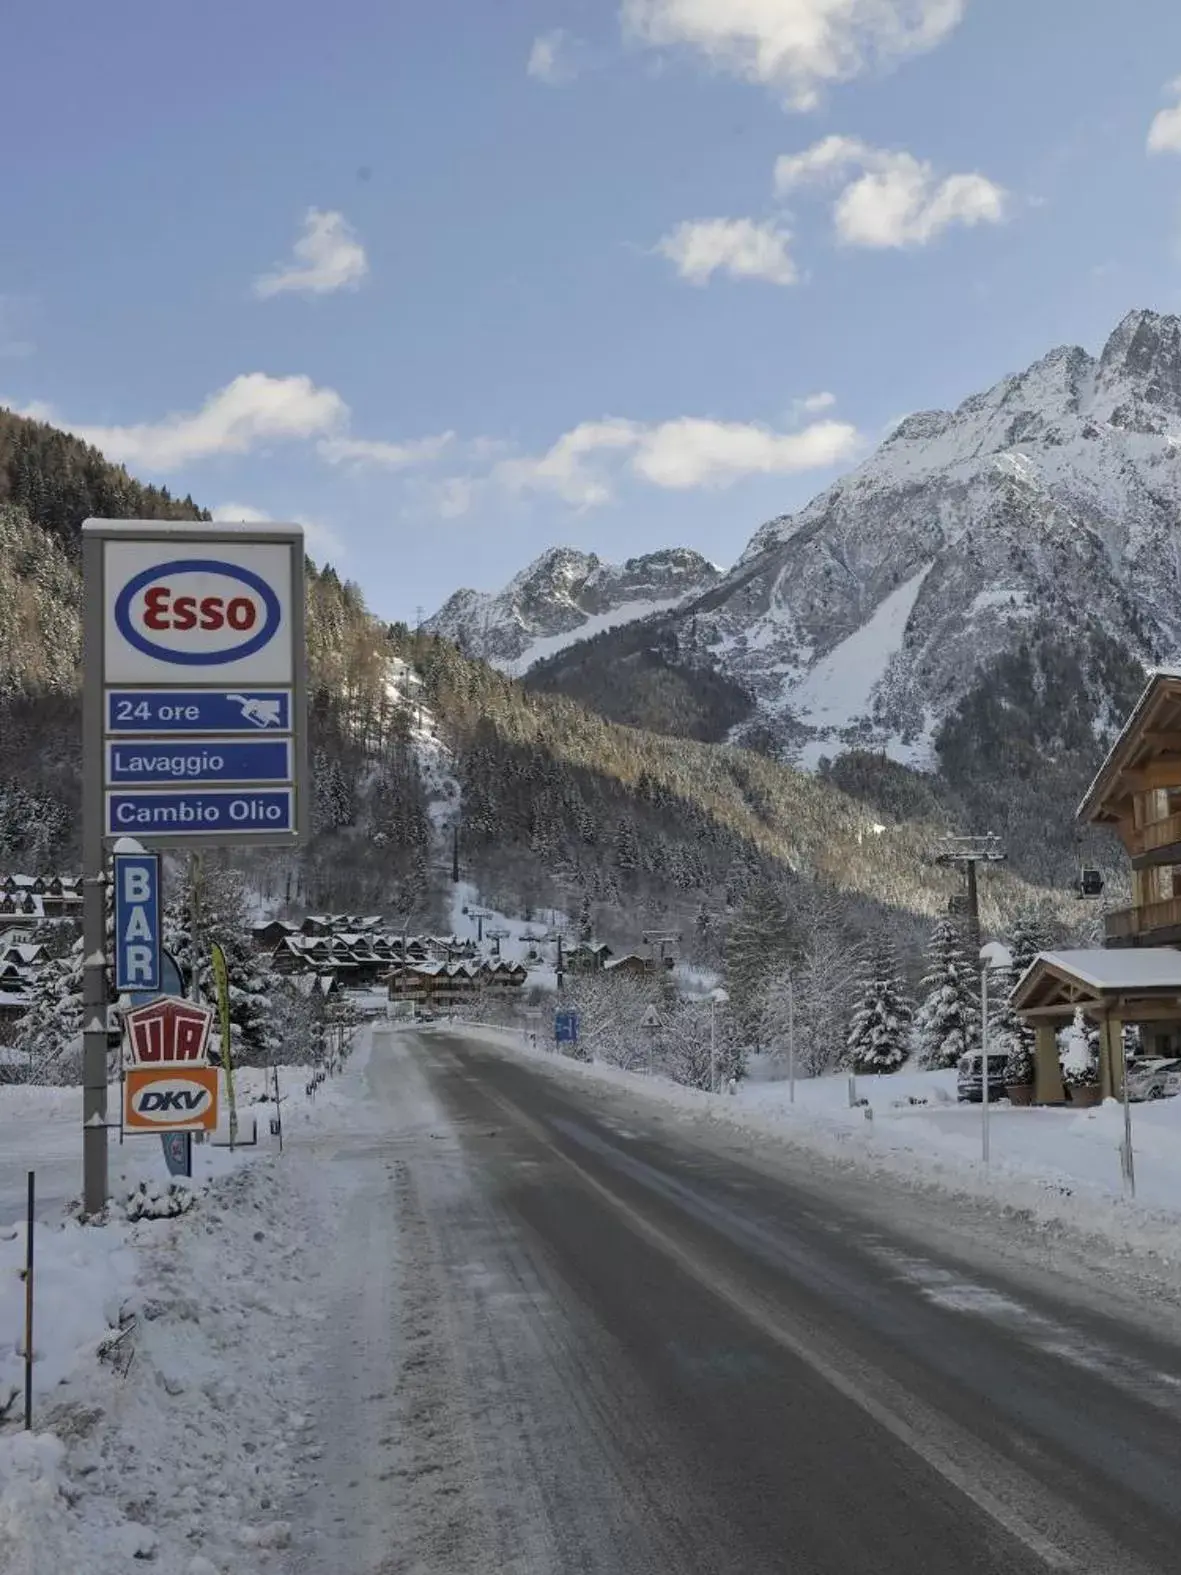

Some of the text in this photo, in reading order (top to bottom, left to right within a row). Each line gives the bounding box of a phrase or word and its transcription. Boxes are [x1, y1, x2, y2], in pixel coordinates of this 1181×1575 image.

[143, 587, 256, 631] Esso
[116, 701, 200, 721] 24 ore
[114, 752, 224, 776] Lavaggio
[116, 800, 281, 823] Cambio Olio
[124, 867, 152, 981] BAR
[138, 1090, 206, 1112] DKV
